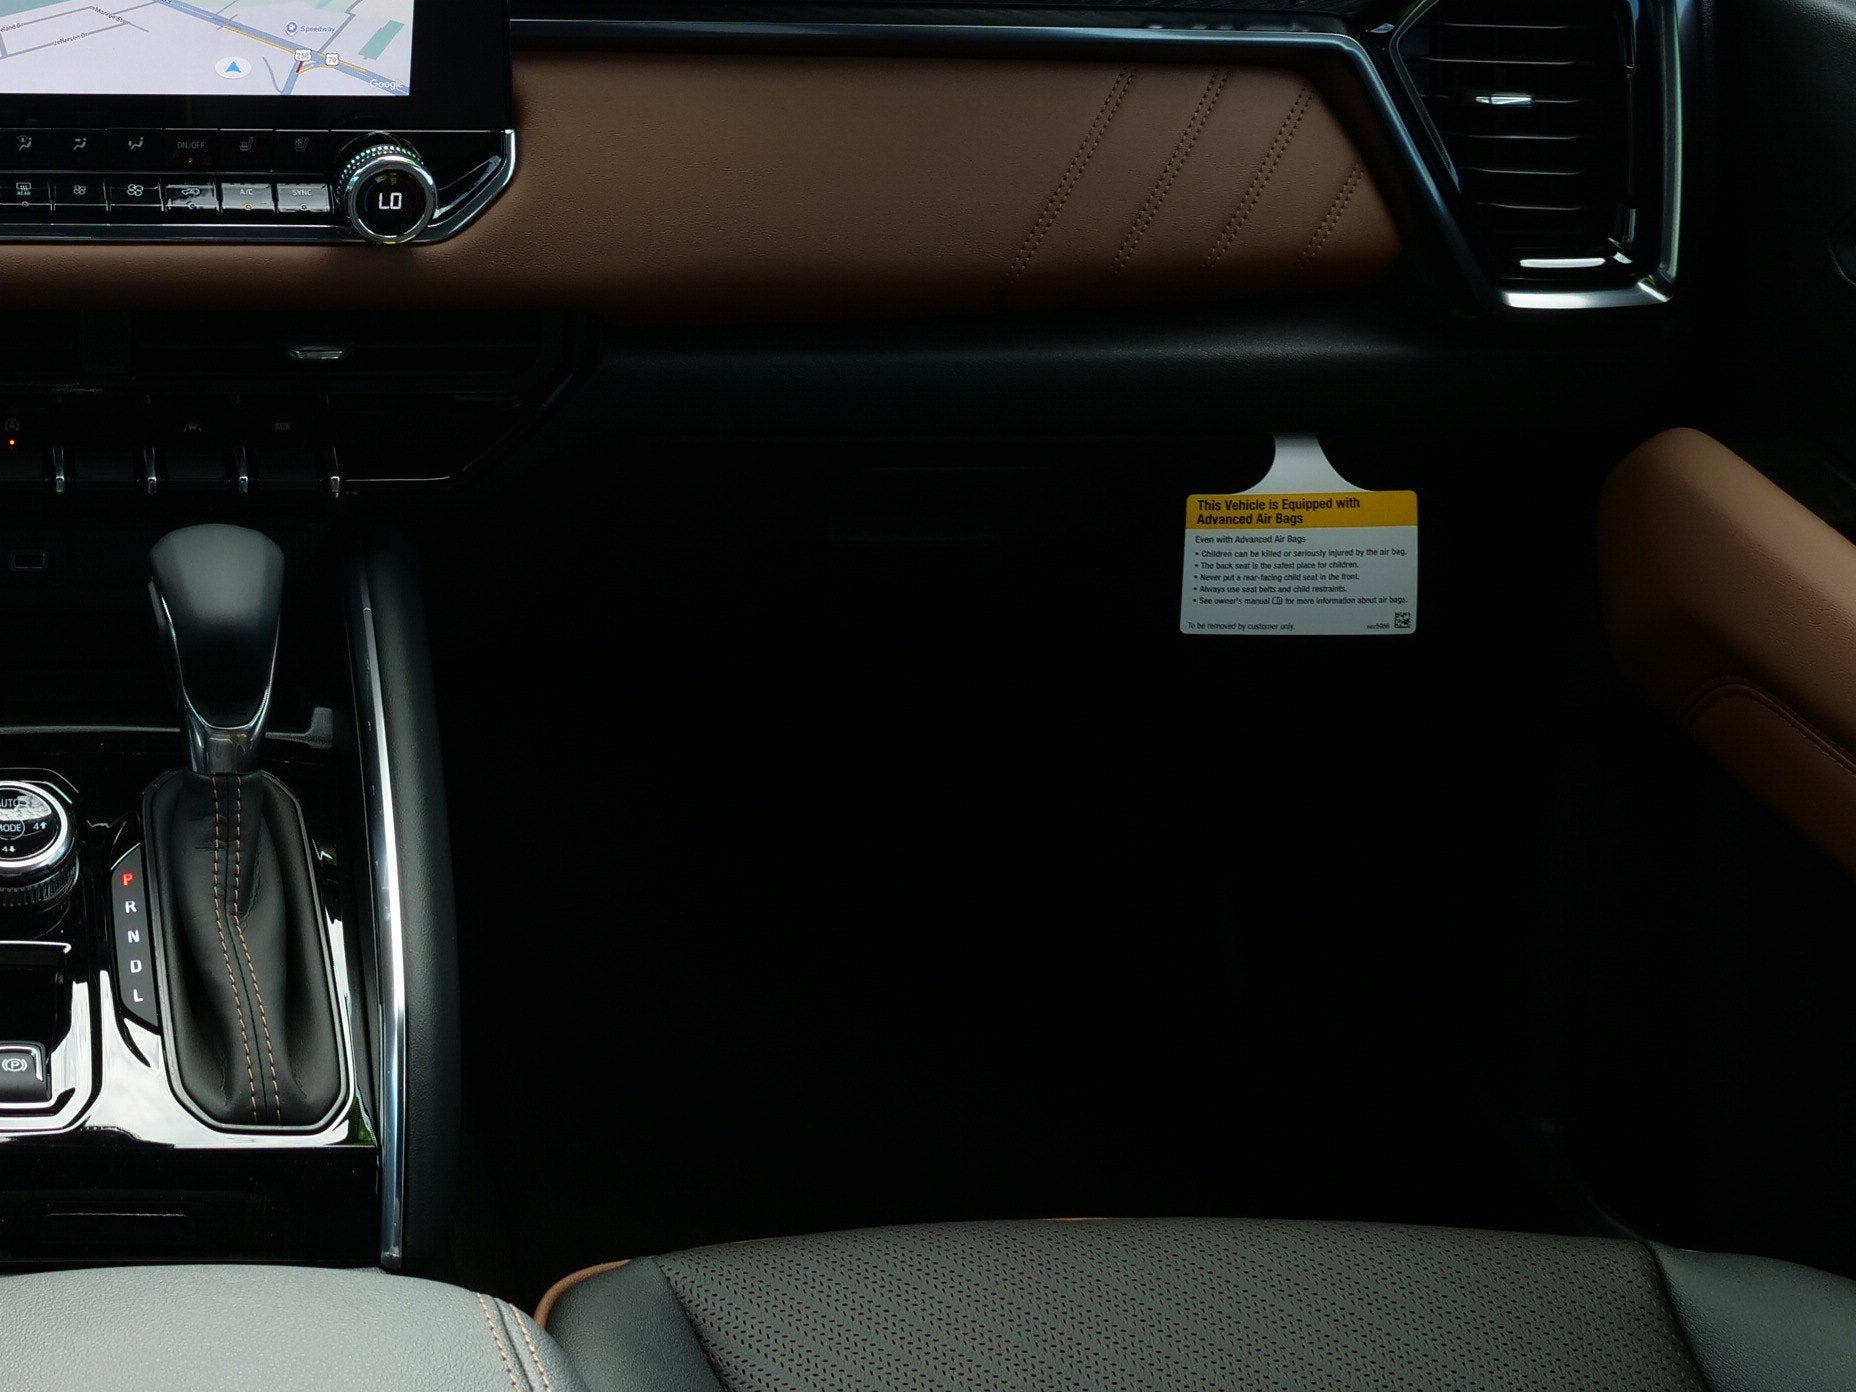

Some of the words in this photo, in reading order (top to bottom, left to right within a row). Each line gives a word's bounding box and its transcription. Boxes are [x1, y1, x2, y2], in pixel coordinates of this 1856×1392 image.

[300, 25, 335, 35] Speedway
[369, 79, 403, 90] Google
[177, 141, 205, 150] ON/OFF
[1197, 500, 1221, 511] This
[1225, 500, 1266, 511] Vehicle
[1270, 499, 1278, 510] is
[1282, 498, 1333, 512] Equipped
[1336, 497, 1360, 508] with
[1197, 513, 1253, 525] Advanced
[1256, 513, 1272, 524] Air
[1275, 513, 1303, 526] Bags
[1195, 535, 1214, 544] Even
[1216, 535, 1233, 544] with
[1235, 535, 1273, 544] Advanced
[1274, 535, 1285, 543] Air
[1287, 535, 1306, 544] Bags
[1201, 550, 1232, 558] Children
[1293, 550, 1326, 558] seriously
[1328, 549, 1354, 558] injured
[1356, 549, 1364, 557] by
[1380, 548, 1390, 556] air
[1391, 548, 1408, 557] bag.
[1207, 622, 1236, 630] removed
[1238, 622, 1247, 631] by
[1280, 623, 1296, 631] only.
[122, 873, 134, 886] P
[125, 900, 137, 913] R
[127, 929, 140, 943] N
[130, 960, 141, 973] D
[133, 989, 144, 1003] L
